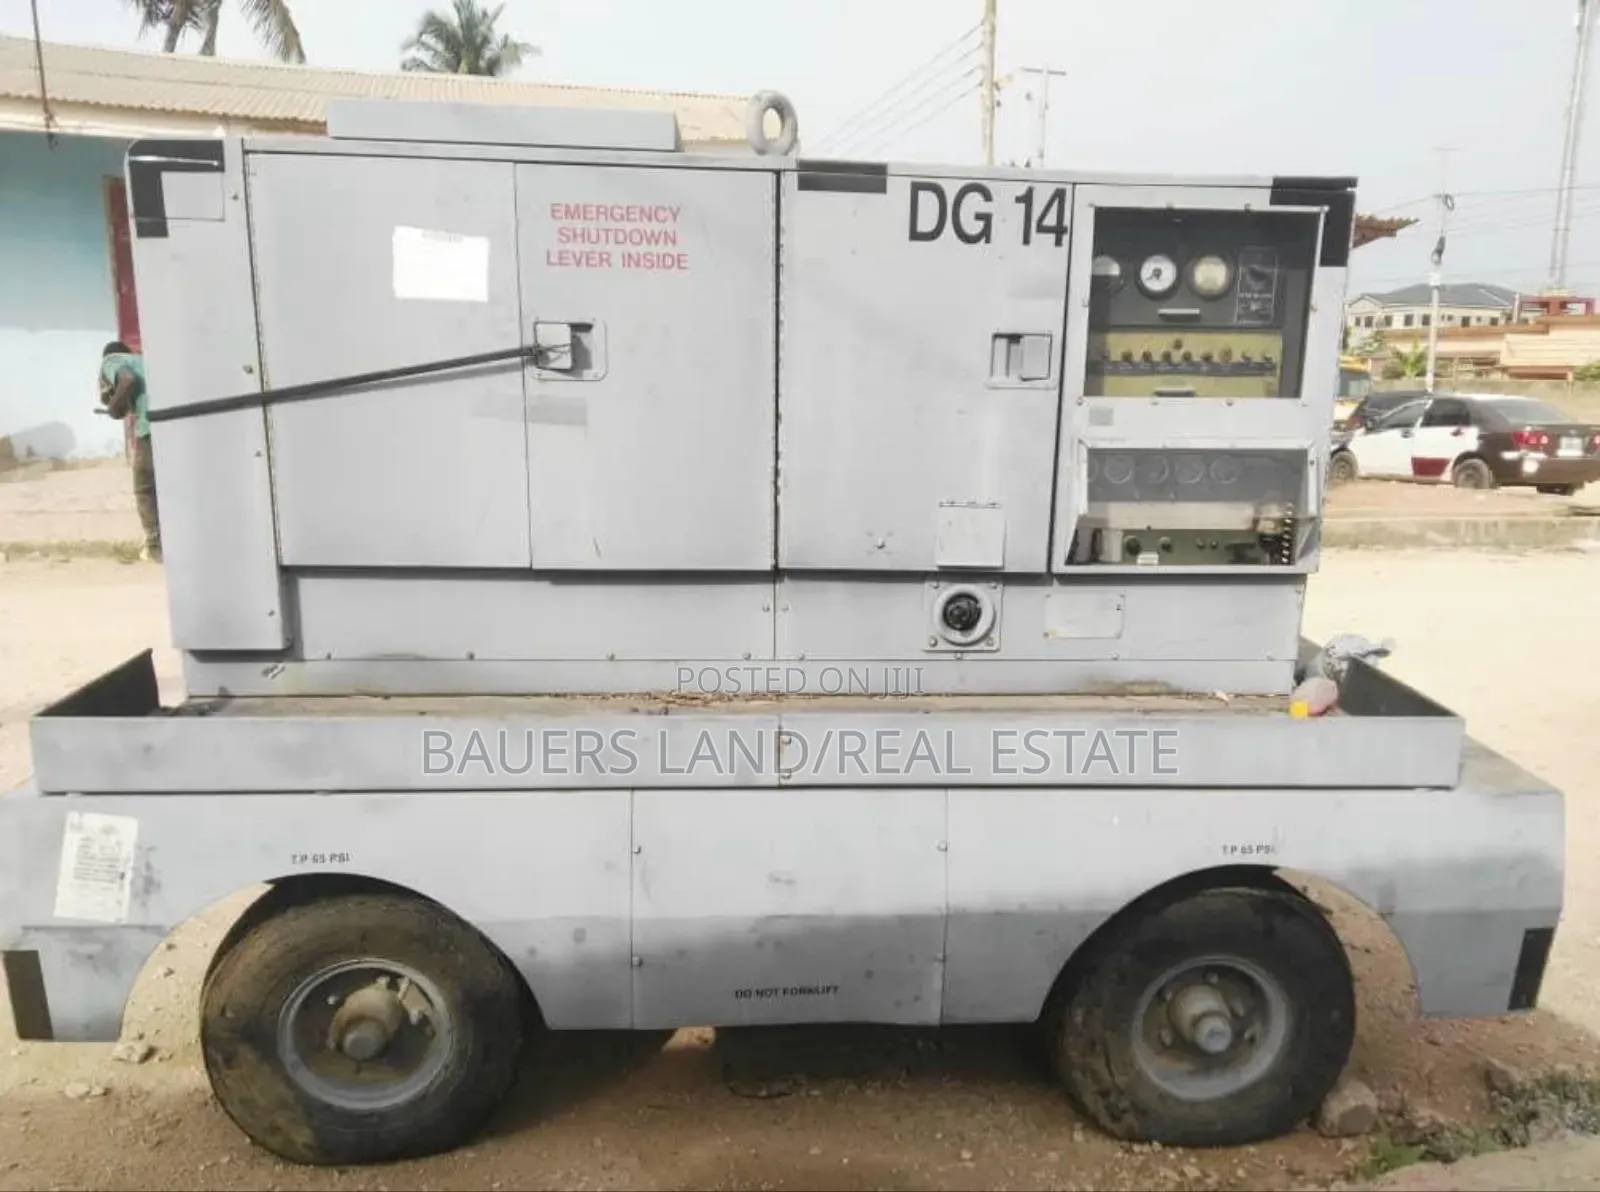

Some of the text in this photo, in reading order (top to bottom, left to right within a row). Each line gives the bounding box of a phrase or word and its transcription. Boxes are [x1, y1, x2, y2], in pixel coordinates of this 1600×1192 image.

[550, 203, 682, 223] EMERGENCY
[908, 180, 1069, 247] DG 14
[557, 226, 678, 246] SHUTDOWN
[546, 249, 690, 270] LEVER INSIDE
[735, 984, 839, 999] DO NOT FORKLIFT
